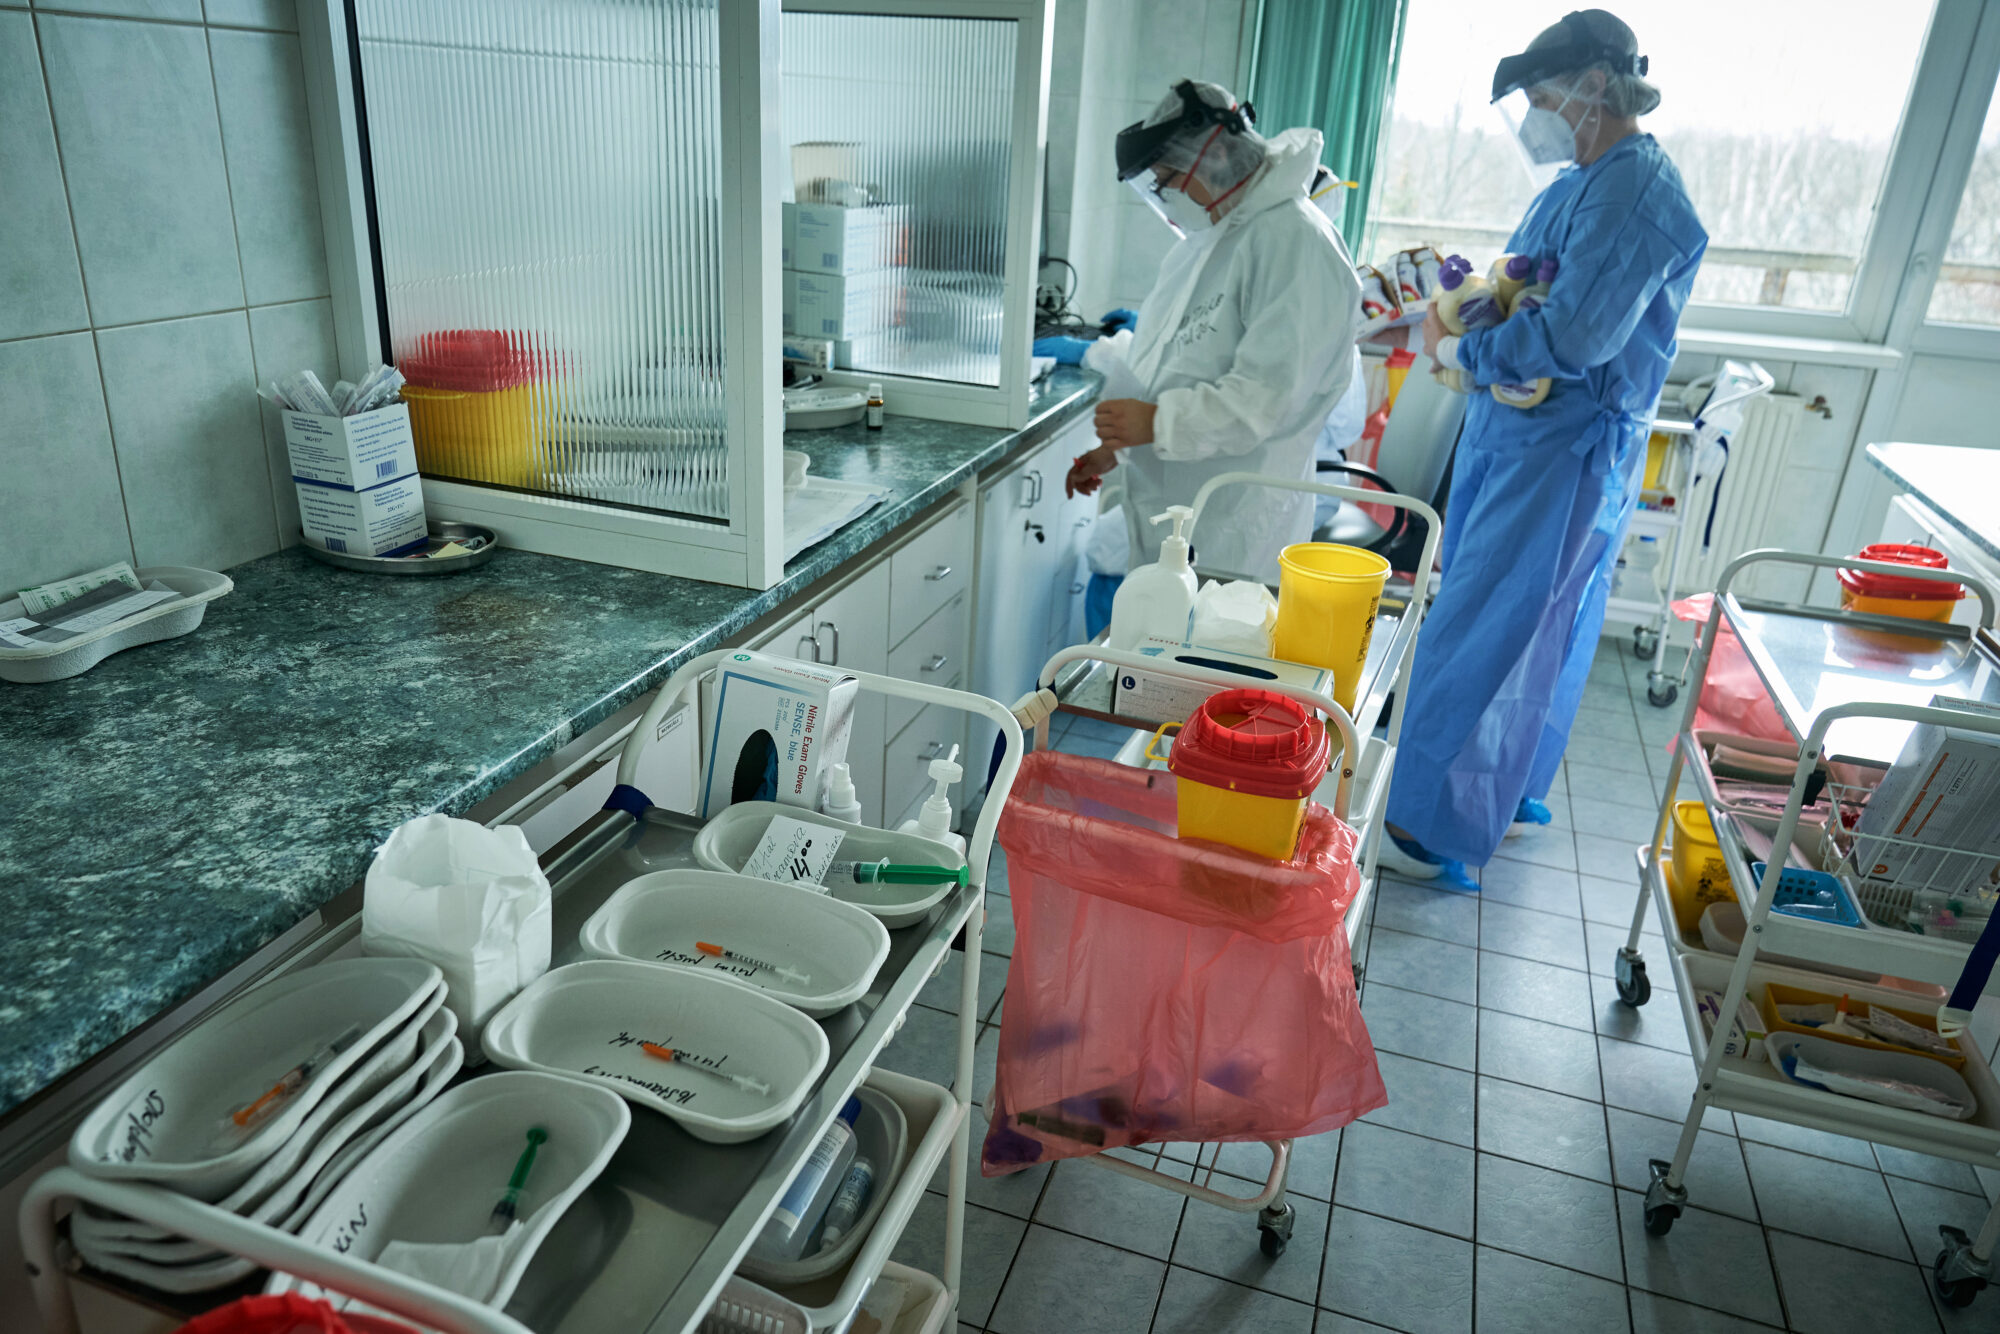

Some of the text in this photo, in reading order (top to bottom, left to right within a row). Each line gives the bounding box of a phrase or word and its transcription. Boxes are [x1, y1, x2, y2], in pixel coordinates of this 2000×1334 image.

[787, 701, 806, 761] SENSE, blue
[794, 704, 819, 794] Nitrile Exam Gloves
